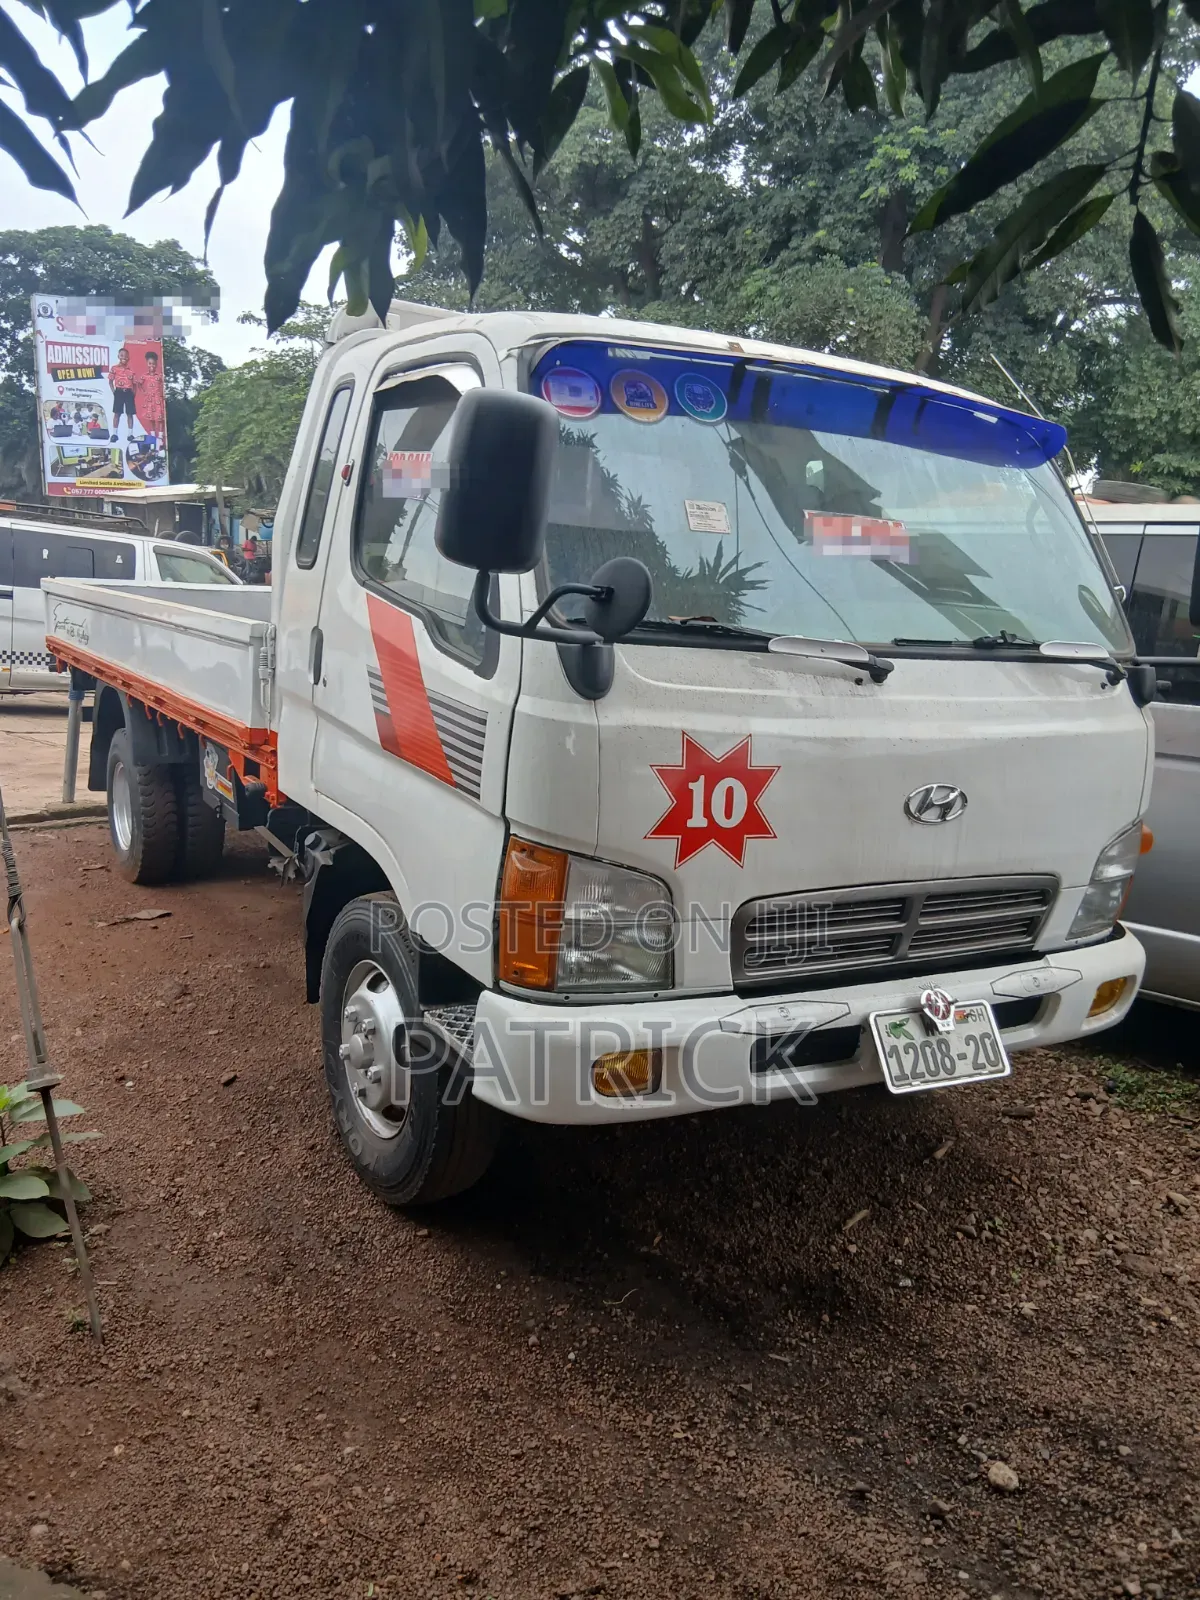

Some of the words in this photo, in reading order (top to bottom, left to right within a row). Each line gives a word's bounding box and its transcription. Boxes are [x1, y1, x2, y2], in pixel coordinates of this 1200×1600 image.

[47, 344, 109, 366] ADMISSION
[57, 368, 75, 380] OPEN
[77, 367, 96, 378] NOW!
[686, 774, 748, 829] 10
[887, 1031, 1000, 1081] 1208-20
